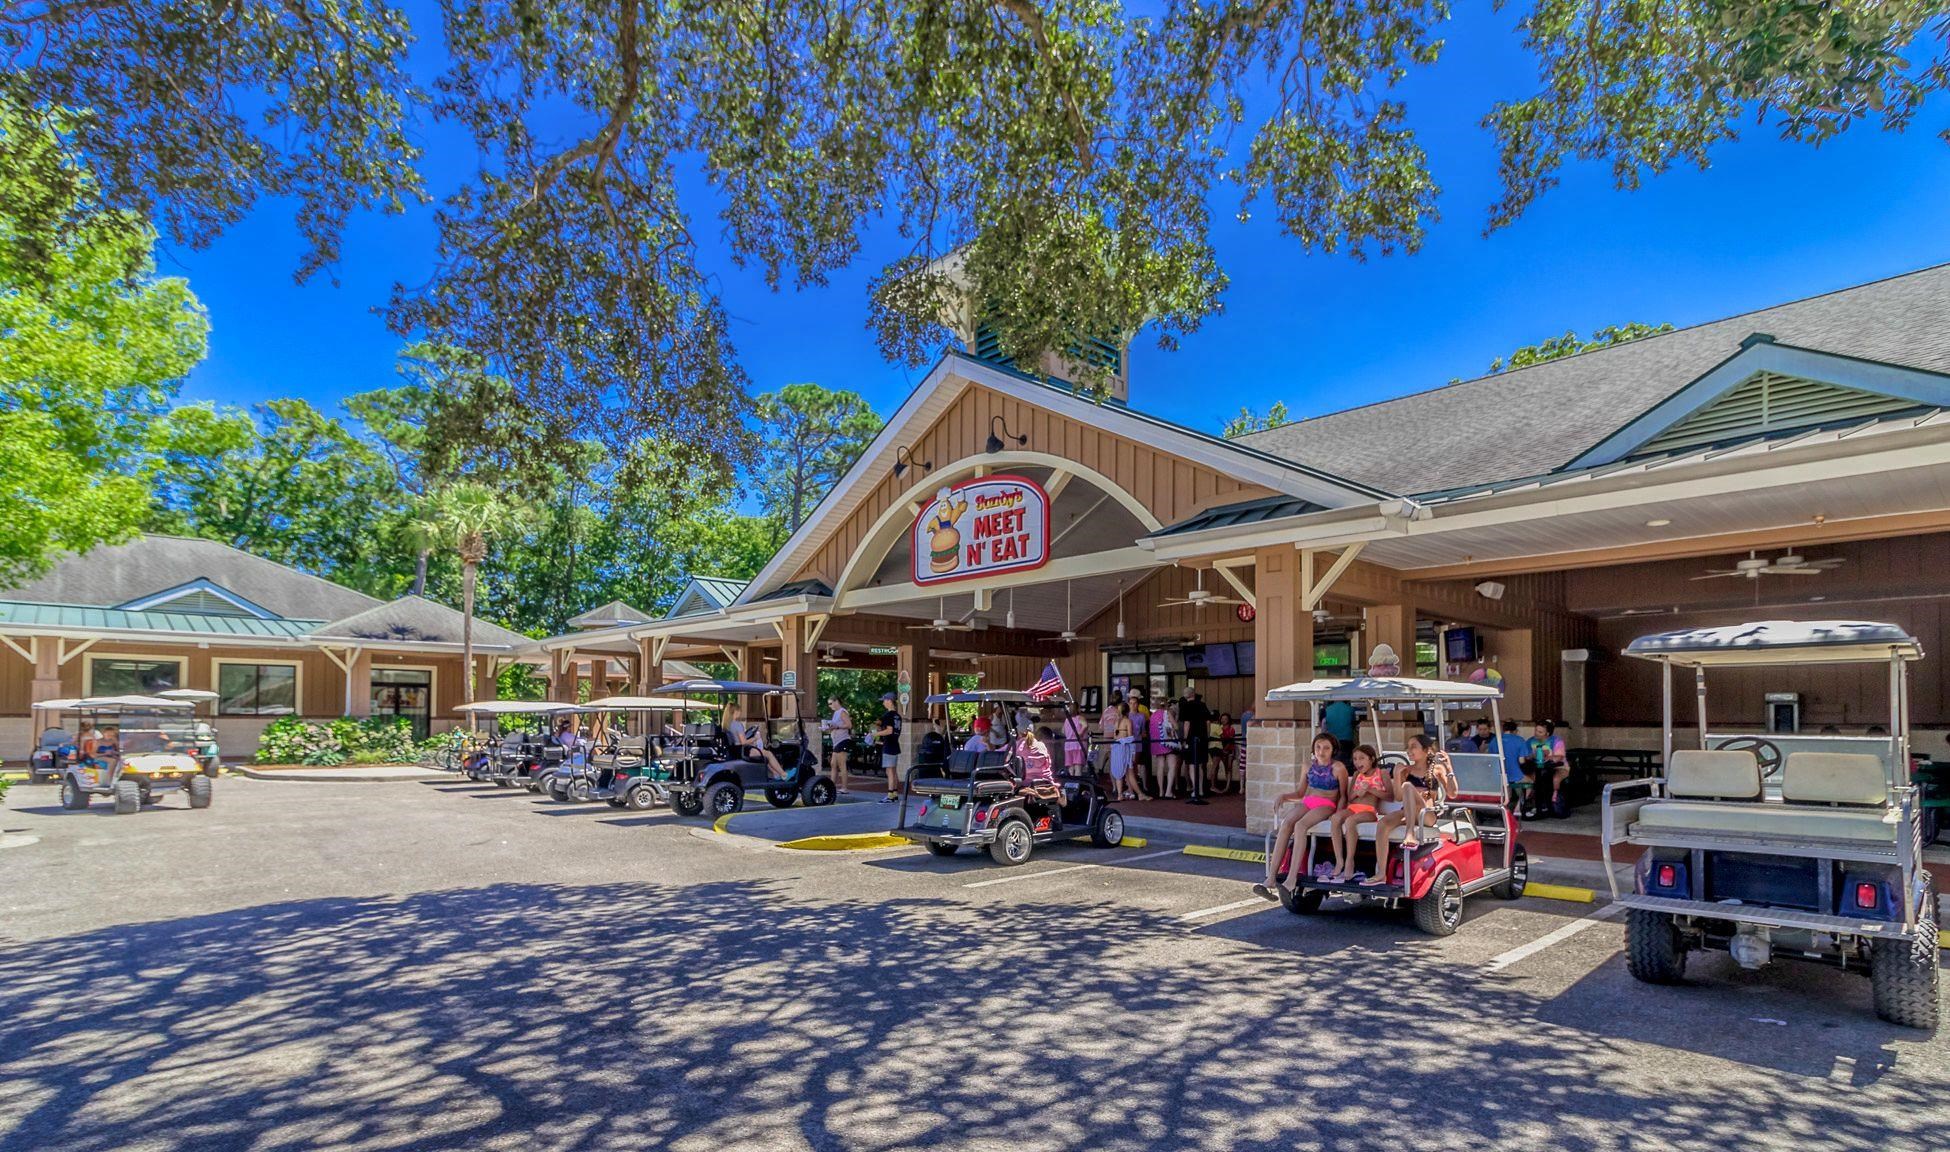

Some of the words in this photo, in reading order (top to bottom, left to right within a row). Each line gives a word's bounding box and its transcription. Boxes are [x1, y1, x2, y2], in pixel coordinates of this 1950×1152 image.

[974, 507, 1026, 540] MEET
[967, 541, 986, 567] N'
[992, 533, 1030, 562] EAT
